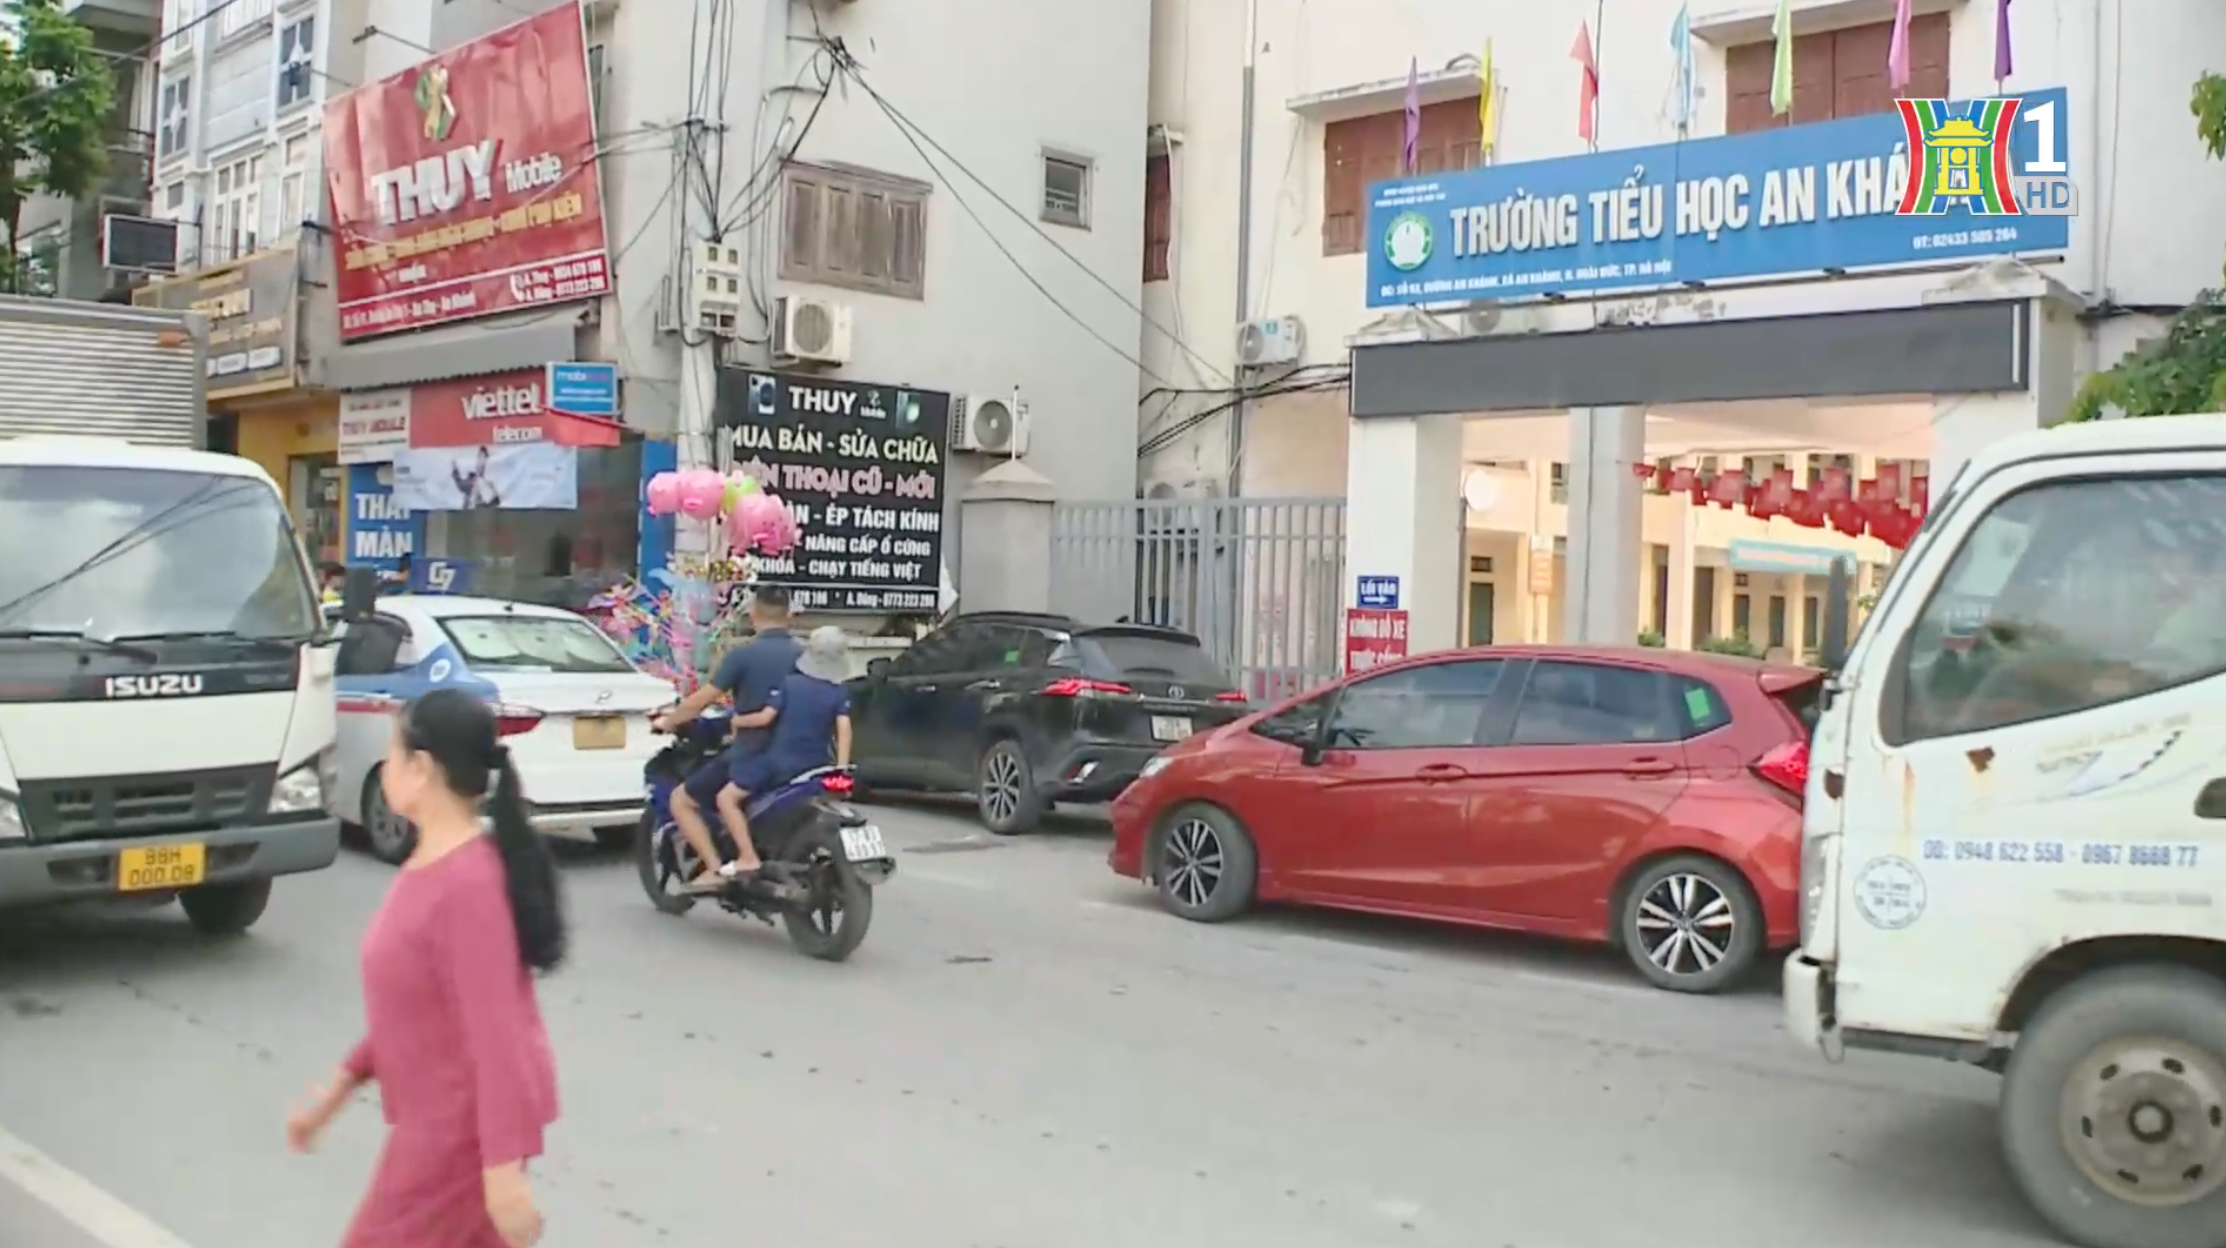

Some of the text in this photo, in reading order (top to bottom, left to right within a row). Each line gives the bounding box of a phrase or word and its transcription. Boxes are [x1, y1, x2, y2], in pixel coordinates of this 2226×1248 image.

[371, 140, 563, 225] THUY Mobile
[1450, 142, 1905, 258] TRƯỜNG TIỂU HỌC AN KHÁ
[461, 382, 544, 419] viettel
[788, 386, 857, 415] THUY
[493, 425, 543, 443] telecom
[778, 423, 823, 454] BÁN
[838, 427, 879, 459] SỬA
[884, 435, 939, 464] CHỮA
[783, 465, 849, 499] THOẠI
[852, 465, 882, 496] CŨ
[896, 469, 935, 500] MỚI
[852, 504, 895, 530] TÁCH
[900, 507, 939, 532] KÍNH
[805, 533, 846, 553] NÂNG
[849, 533, 878, 554] CẤP
[894, 538, 931, 556] CỨNG
[809, 560, 847, 579] CHẠY
[850, 557, 891, 577] TIẾNG
[893, 561, 922, 581] VIỆT
[1377, 579, 1396, 595] VÀO
[106, 675, 203, 697] ISUZU
